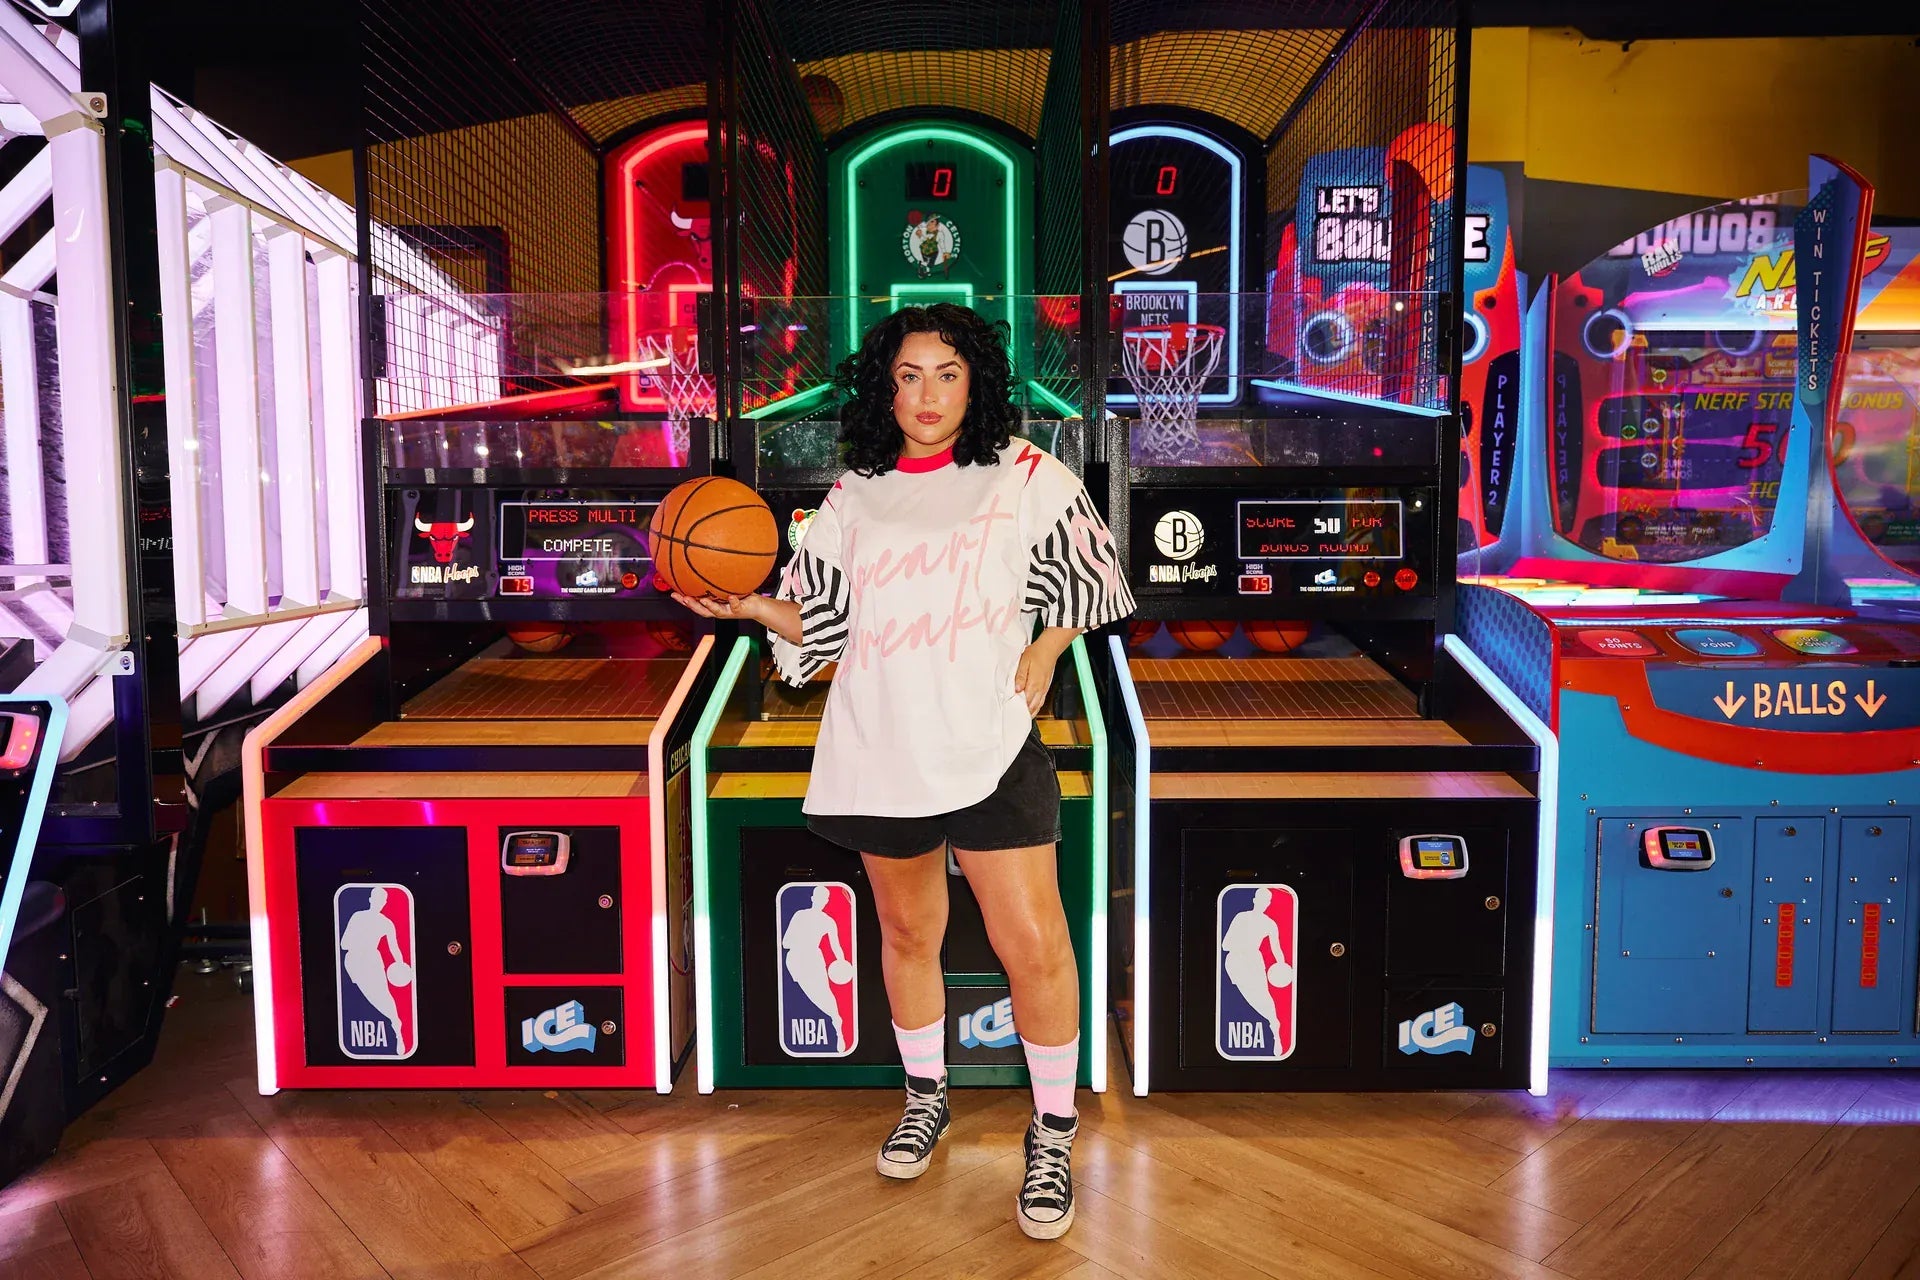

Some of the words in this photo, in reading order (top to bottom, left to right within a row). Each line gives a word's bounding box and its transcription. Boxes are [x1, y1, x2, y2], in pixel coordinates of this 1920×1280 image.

[932, 168, 952, 197] 0
[1156, 166, 1177, 195] 0
[902, 223, 914, 264] BOSTON
[945, 219, 961, 262] CELTICS
[1146, 219, 1166, 265] B
[1316, 216, 1488, 261] BOUE
[1811, 209, 1827, 260] WIN
[1641, 238, 1680, 267] RAW
[1126, 294, 1185, 311] BROOKLYN
[1807, 271, 1823, 392] TICKETS
[1694, 392, 1750, 411] NERF
[1487, 375, 1508, 486] PLAYER
[1489, 490, 1499, 506] 2
[528, 509, 579, 523] PRESS
[588, 509, 636, 523] MULTI
[543, 538, 613, 552] COMPETE
[1172, 518, 1188, 553] B
[420, 566, 442, 583] NBA
[443, 562, 479, 584] Hoops
[513, 579, 530, 592] 75
[1158, 565, 1181, 583] NBA
[1181, 561, 1217, 583] Hoops
[1252, 577, 1268, 591] 75
[1754, 680, 1847, 719] BALLS
[350, 1020, 388, 1047] NBA
[522, 999, 597, 1054] ICE
[791, 1018, 829, 1046] NBA
[958, 996, 1020, 1049] ICE
[1228, 1021, 1265, 1049] NBA
[1399, 1001, 1476, 1055] ICE
